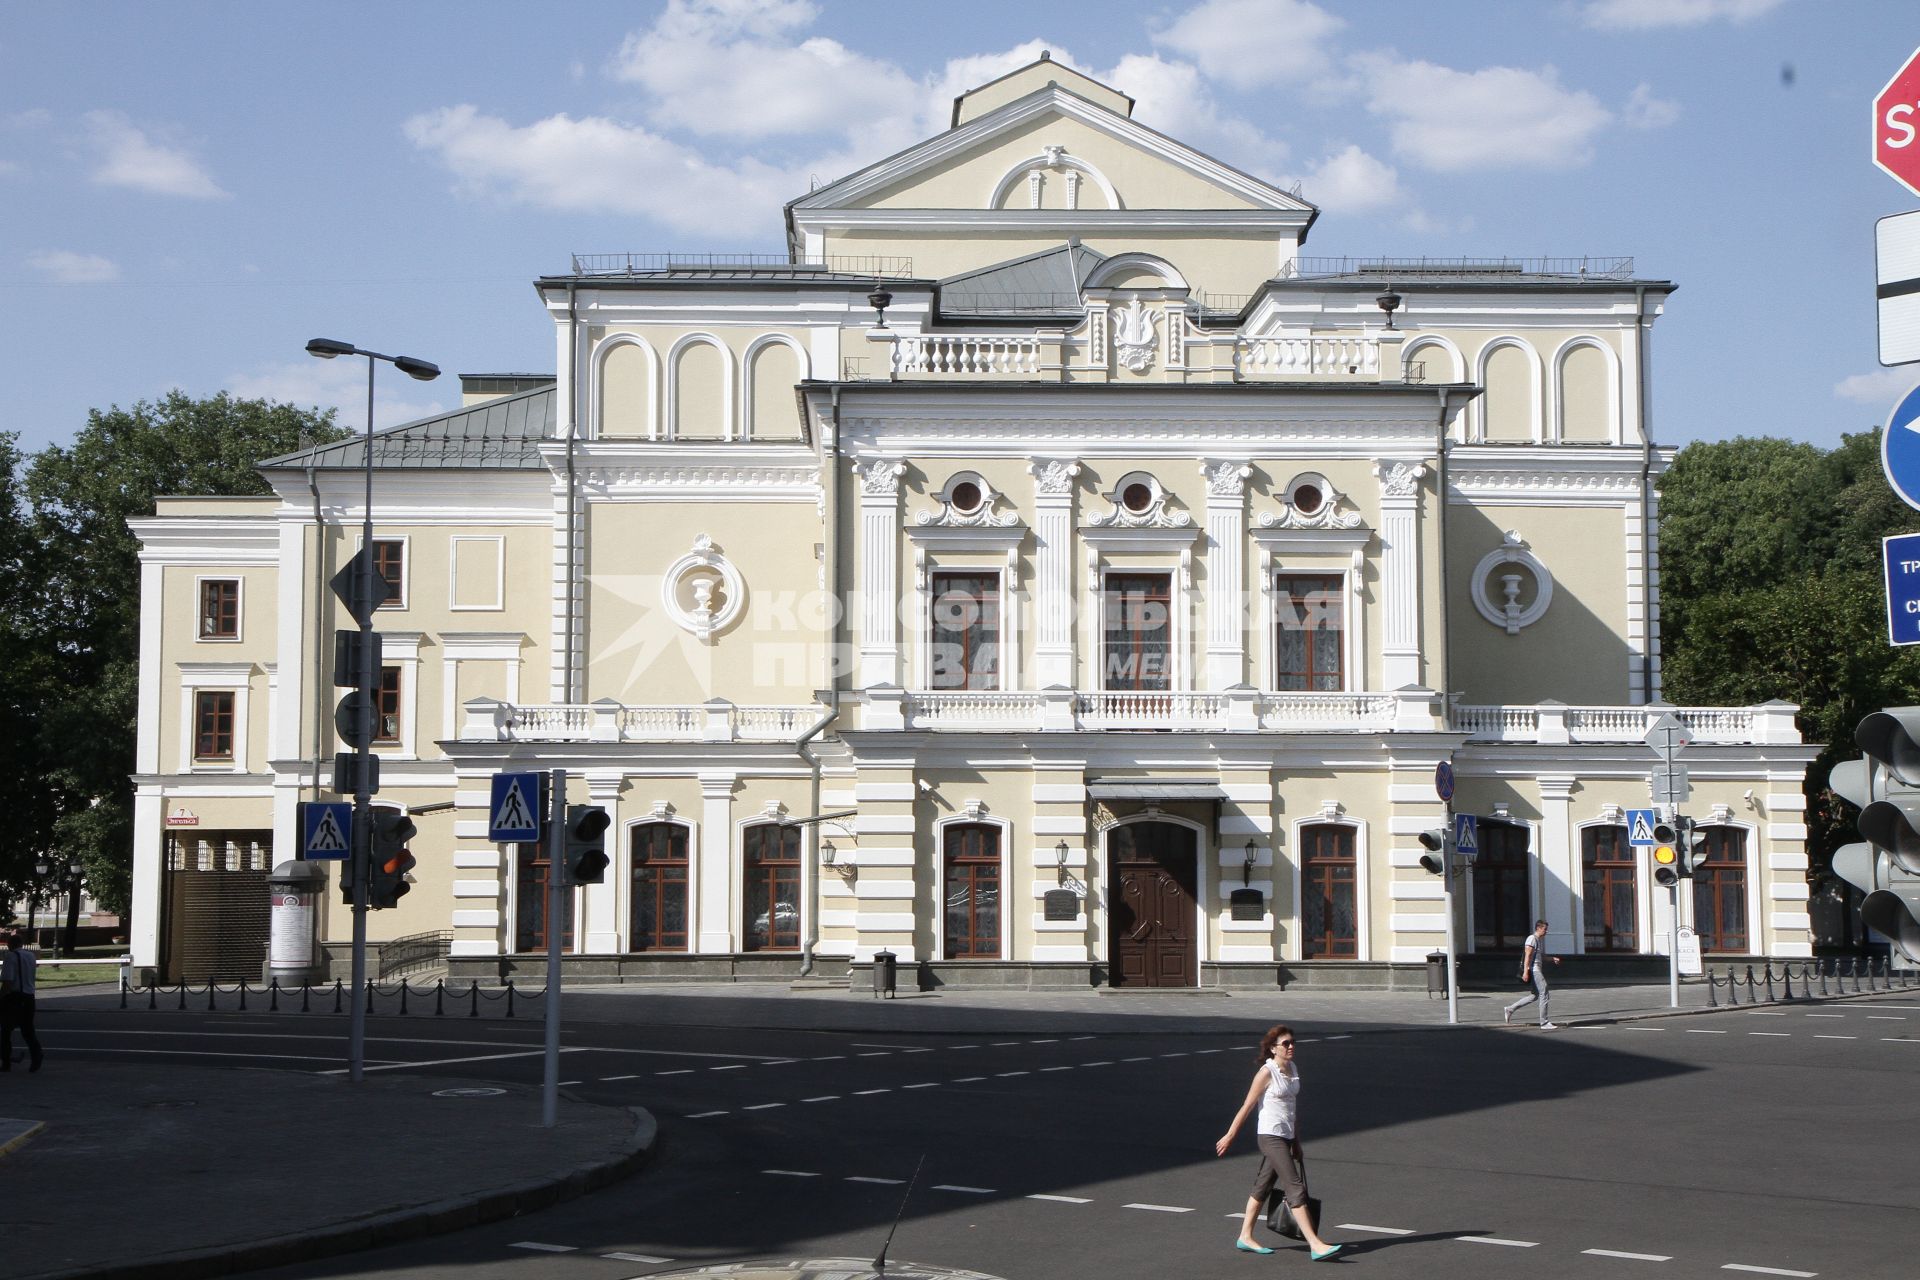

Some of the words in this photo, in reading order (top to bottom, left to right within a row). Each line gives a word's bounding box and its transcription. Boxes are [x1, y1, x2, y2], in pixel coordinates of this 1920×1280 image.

[1885, 103, 1920, 149] S
[1905, 600, 1920, 614] С
[180, 809, 185, 817] 7
